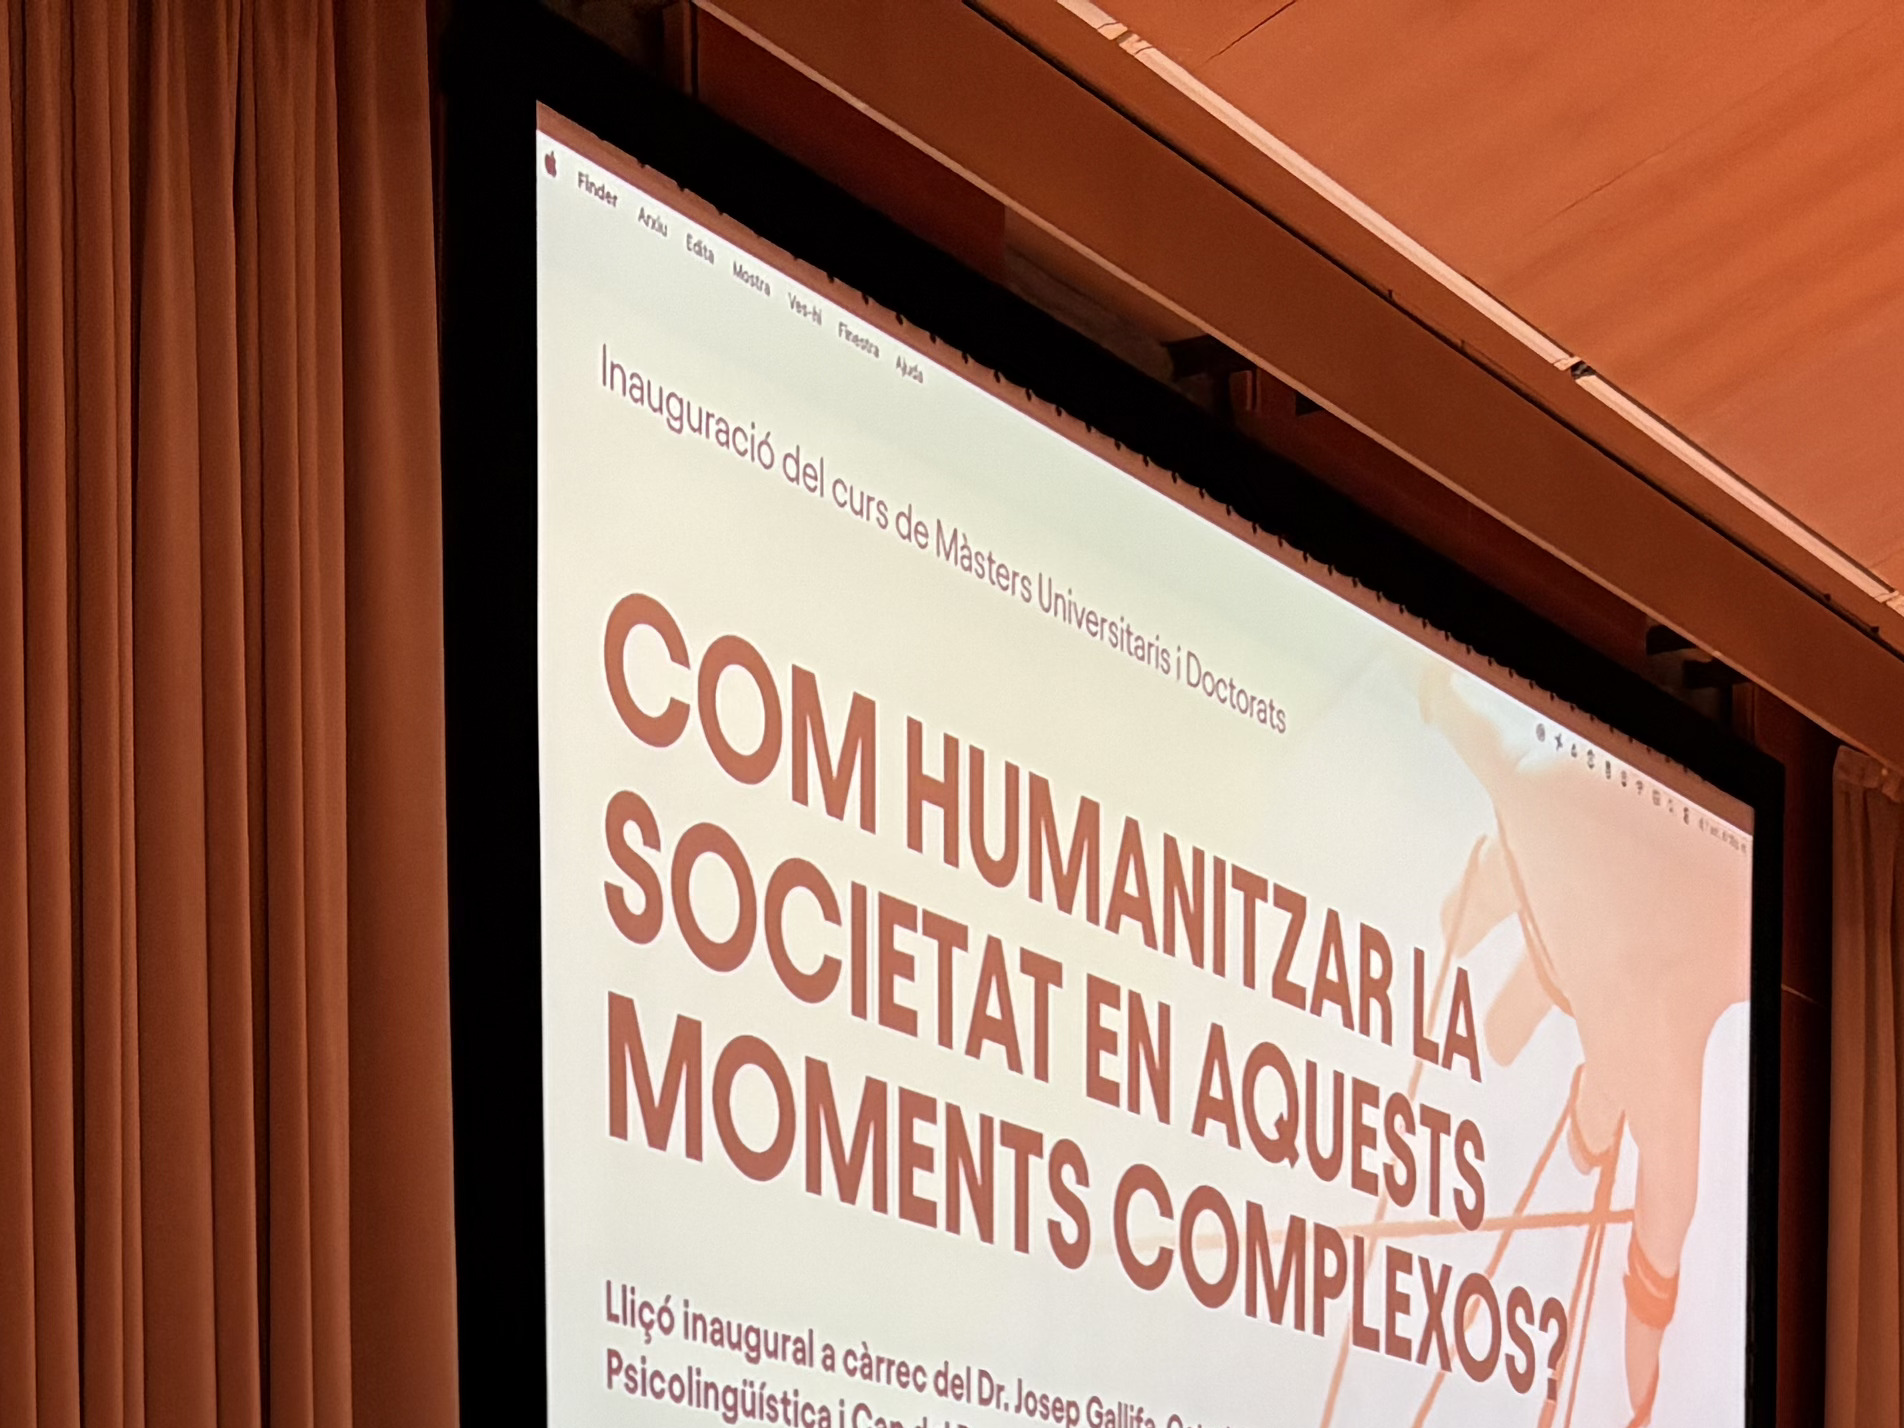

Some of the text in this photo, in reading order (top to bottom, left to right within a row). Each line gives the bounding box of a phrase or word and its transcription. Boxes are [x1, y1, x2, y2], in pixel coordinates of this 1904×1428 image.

[577, 170, 924, 385] Finder Arxiu Edita Mostra Ves-hi Finestra Ajuda
[601, 342, 1288, 734] Inauguració del curs de Màsters Universitaris i Doctorats
[603, 592, 1483, 1084] COM HUMANITZAR LA
[603, 789, 1486, 1232] SOCIETAT EN AQUESTS
[605, 1279, 676, 1345] Lliçó
[682, 1298, 815, 1366] inaugural
[821, 1343, 836, 1373] a
[842, 1340, 928, 1394] càrrec
[933, 1359, 972, 1404] del
[977, 1368, 1010, 1412] Dr.
[607, 990, 1569, 1401] MOMENTS COMPLEXOS?
